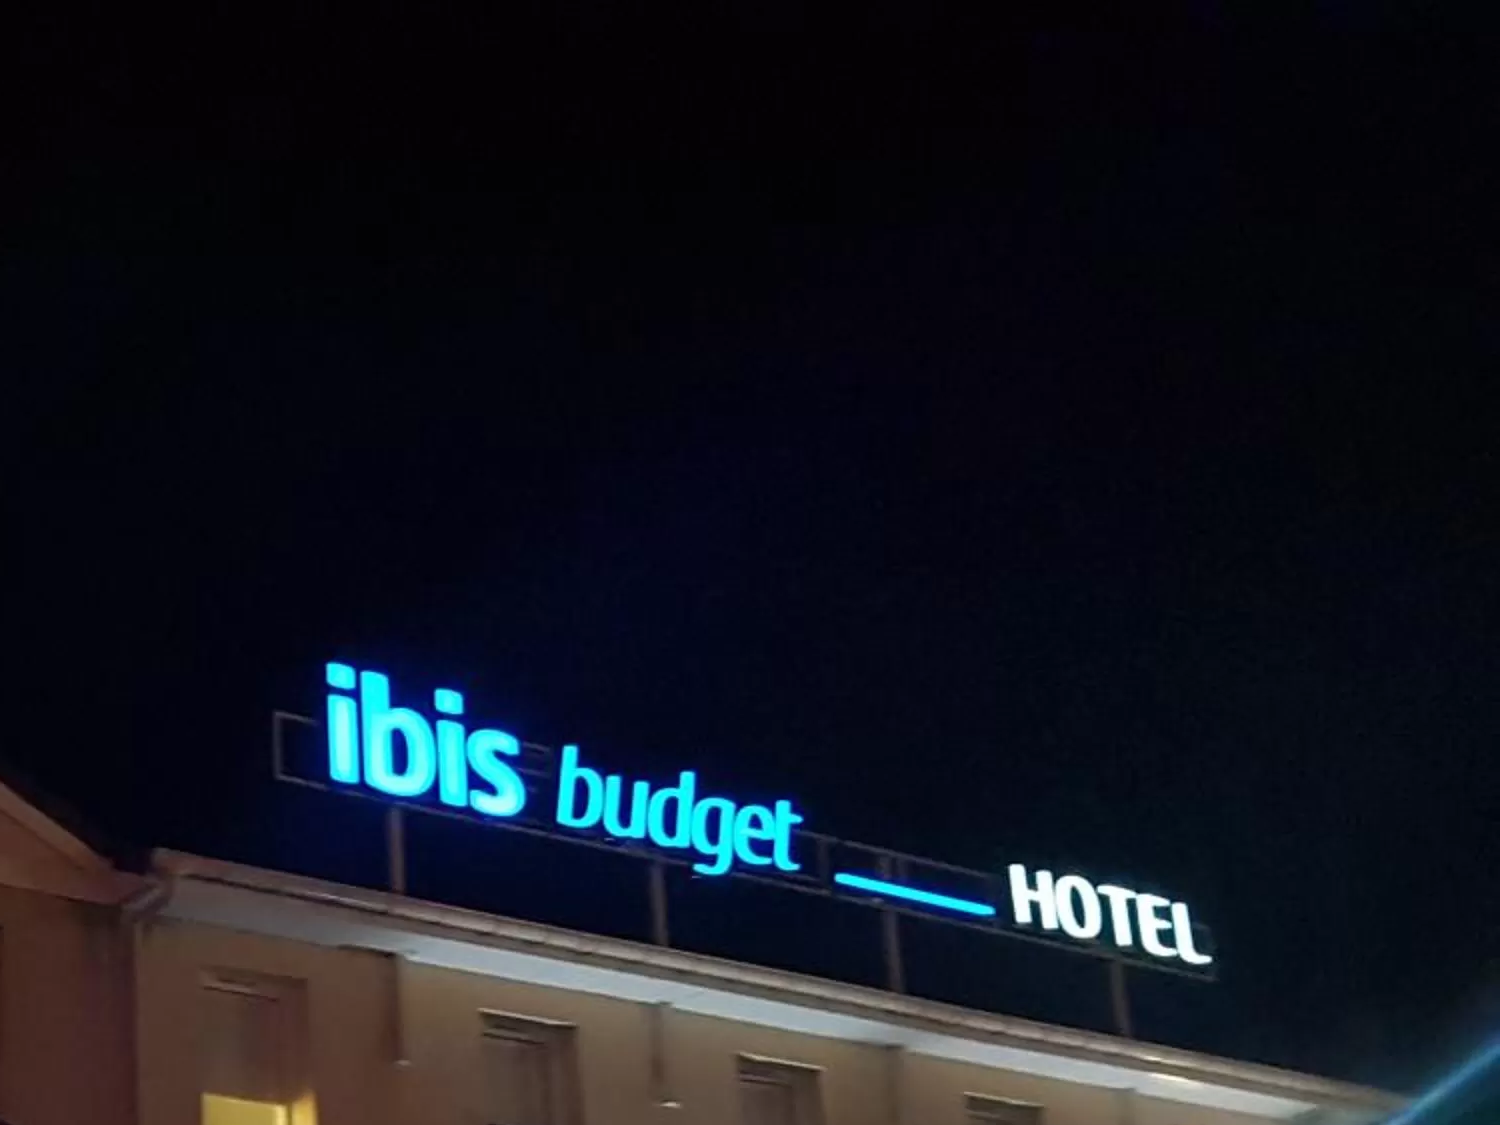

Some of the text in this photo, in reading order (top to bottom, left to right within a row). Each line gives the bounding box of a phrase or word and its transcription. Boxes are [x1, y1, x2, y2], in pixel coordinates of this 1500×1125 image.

[325, 661, 1214, 966] ibis budget HOTEL
